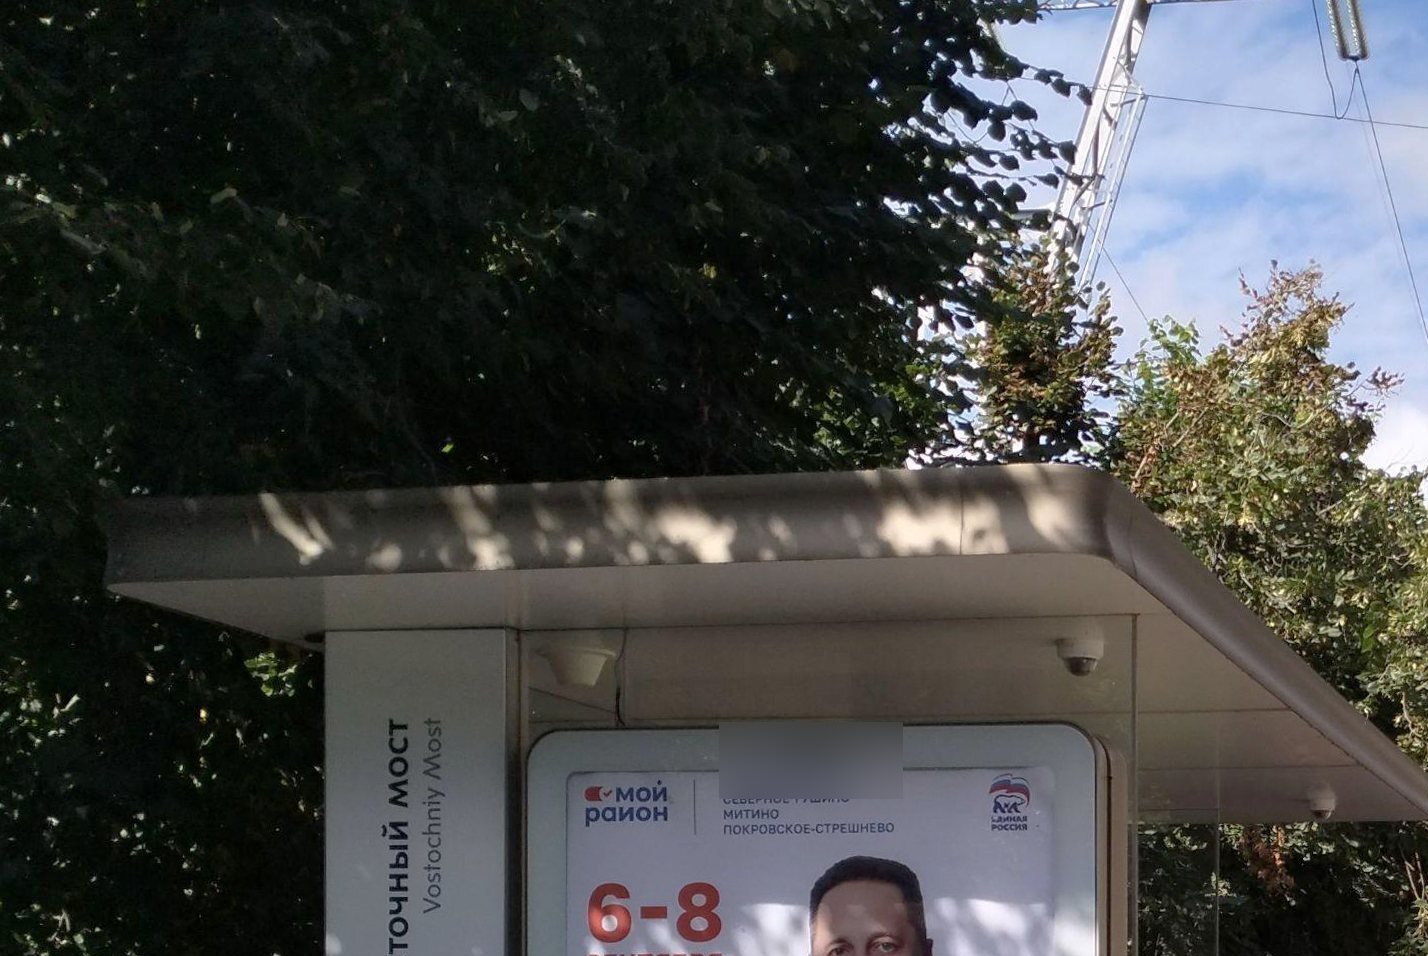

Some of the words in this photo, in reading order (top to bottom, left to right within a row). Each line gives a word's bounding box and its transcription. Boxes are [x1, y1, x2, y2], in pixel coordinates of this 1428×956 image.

[423, 717, 442, 780] Most
[723, 809, 780, 820] МИТИНО
[723, 822, 896, 836] ПОКРОВСКОЕ-СТРЕШНЕВО
[991, 823, 1028, 831] РОССИЯ
[422, 786, 446, 914] Vostochniy
